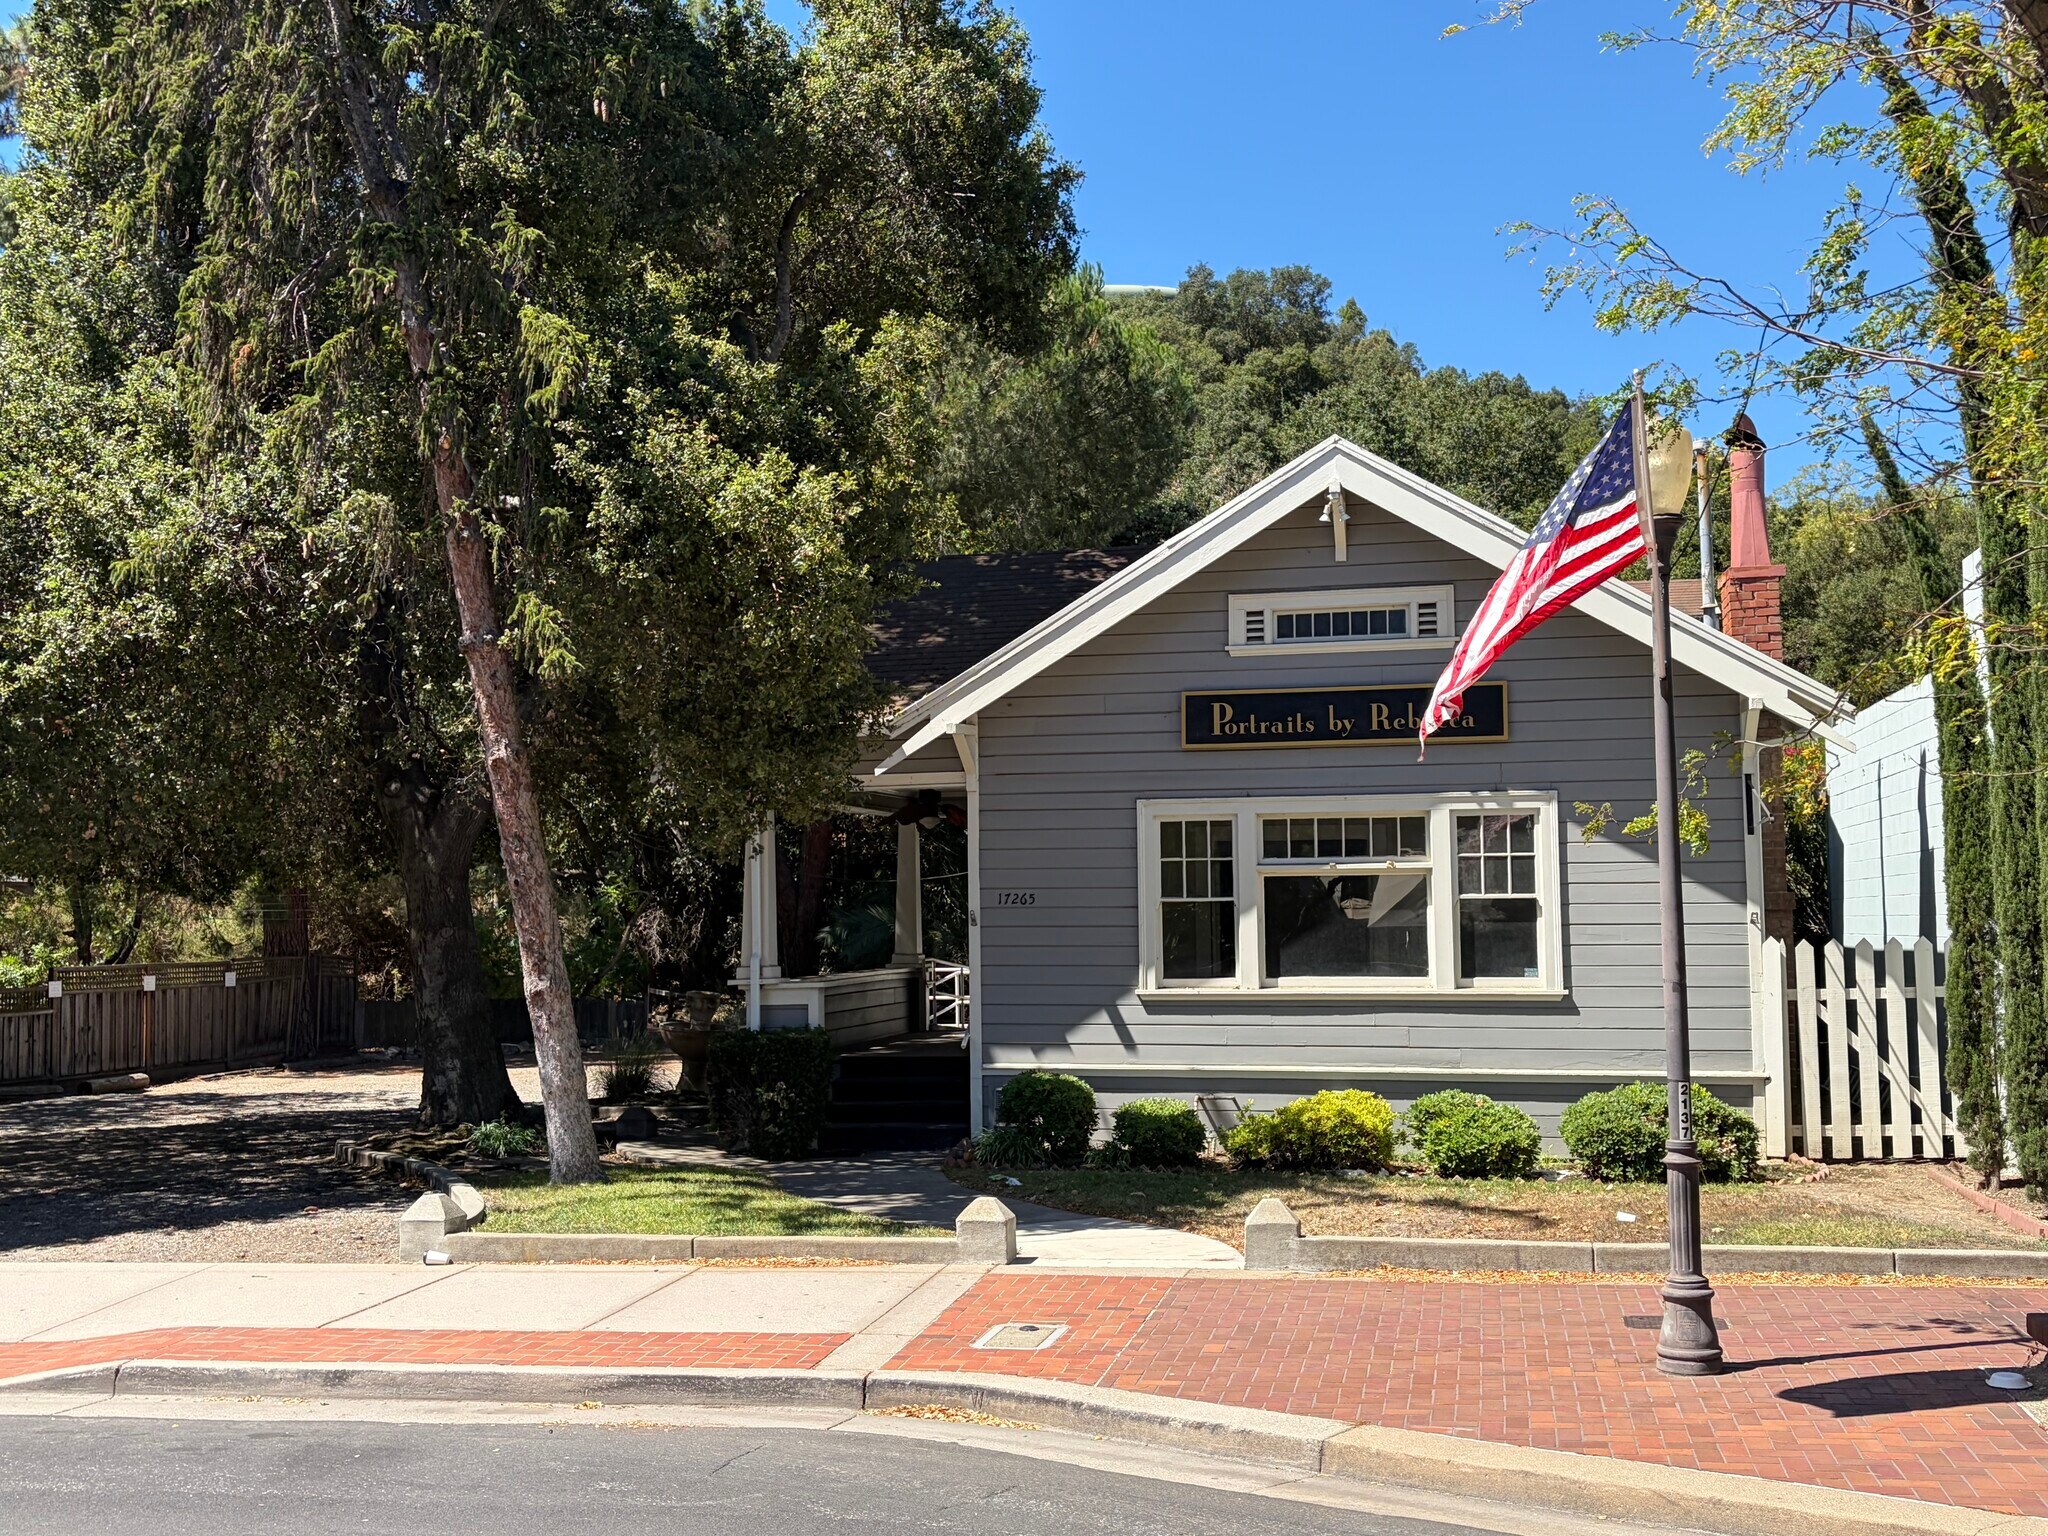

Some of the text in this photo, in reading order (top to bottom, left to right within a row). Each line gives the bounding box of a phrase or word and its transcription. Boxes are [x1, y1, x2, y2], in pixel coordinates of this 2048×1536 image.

[1210, 701, 1476, 737] Portraits by Rebca
[998, 892, 1036, 905] 17265
[1680, 1084, 1689, 1138] 2137
